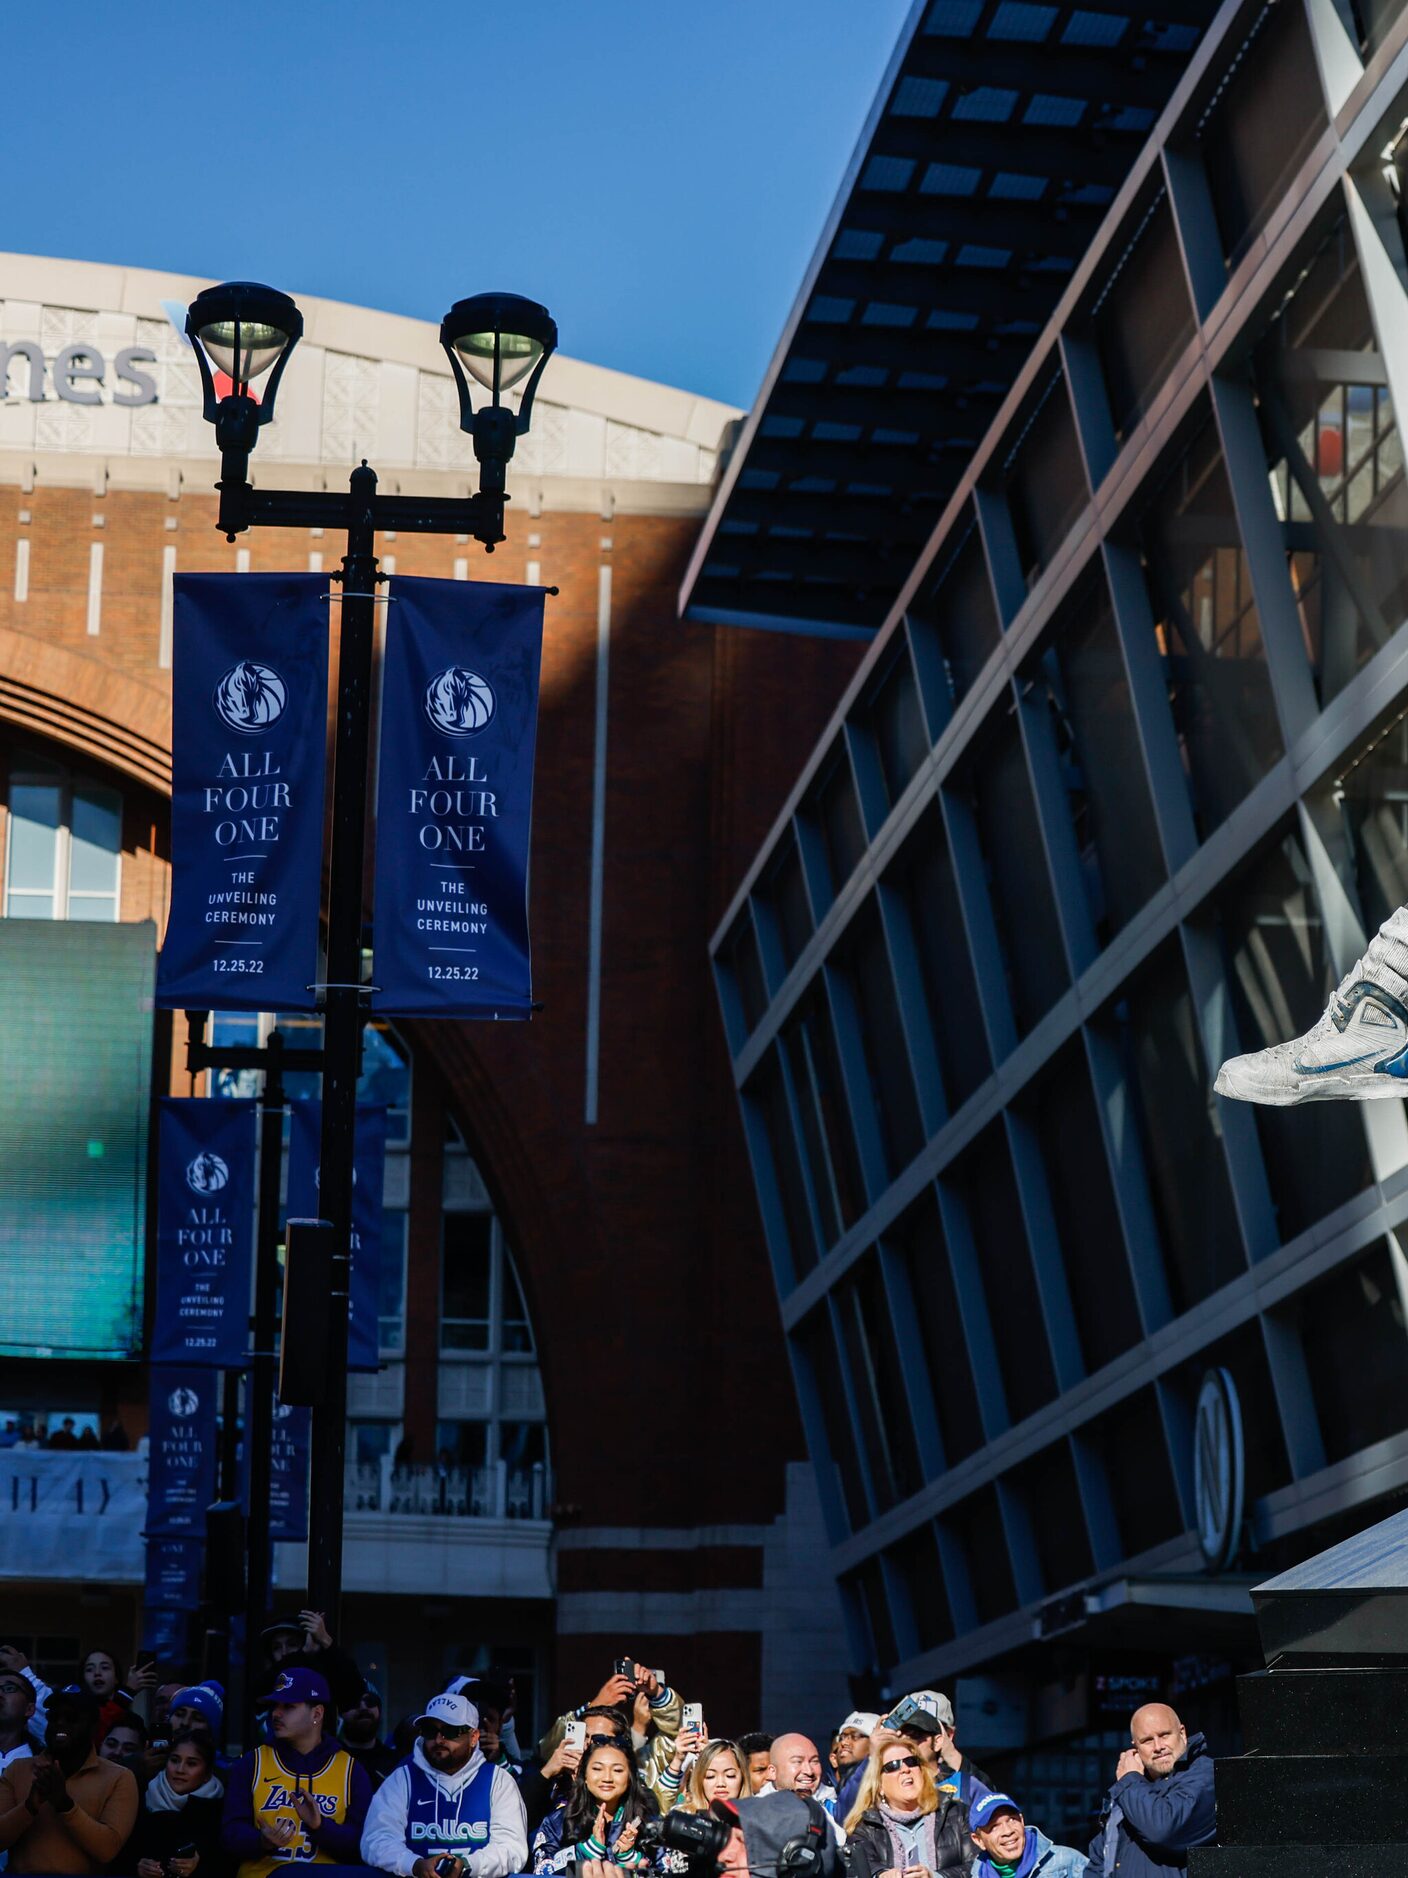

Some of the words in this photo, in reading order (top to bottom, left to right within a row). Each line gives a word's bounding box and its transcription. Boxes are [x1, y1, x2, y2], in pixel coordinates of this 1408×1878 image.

[0, 340, 157, 406] nes
[216, 751, 281, 778] ALL
[421, 755, 488, 782] ALL
[203, 782, 293, 813] FOUR
[408, 789, 500, 818] FOUR
[215, 816, 279, 846] ONE
[419, 824, 486, 851] ONE
[231, 871, 256, 884] THE
[440, 881, 465, 894] THE
[208, 891, 277, 906] UNVEILING
[417, 899, 488, 916] UNVEILING
[205, 911, 276, 926] CEREMONY
[417, 918, 488, 934] CEREMONY
[213, 959, 265, 974] 12.25.22
[428, 966, 479, 981] 12.25.22
[189, 1207, 227, 1225] ALL
[178, 1227, 233, 1246] FOUR
[183, 1249, 226, 1266] ONE
